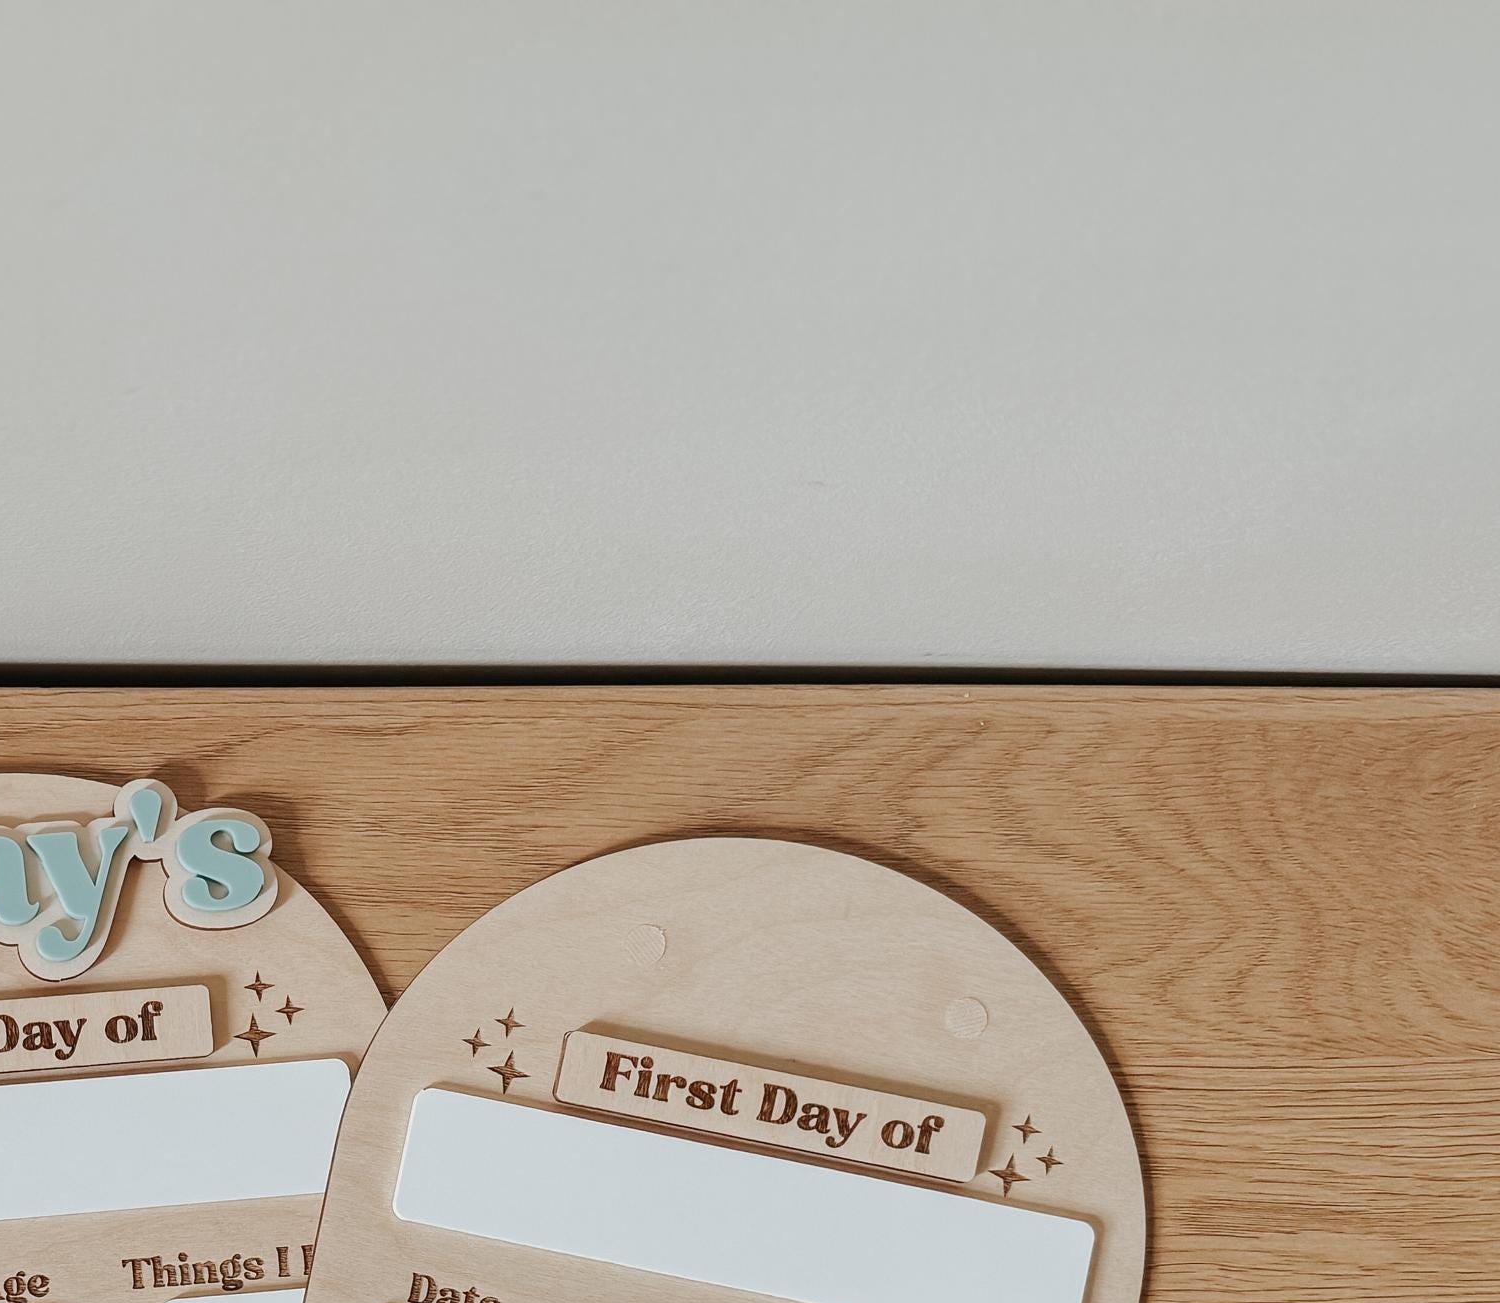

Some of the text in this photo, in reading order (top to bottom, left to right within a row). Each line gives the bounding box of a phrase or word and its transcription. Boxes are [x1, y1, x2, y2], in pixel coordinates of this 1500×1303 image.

[105, 1001, 164, 1044] of
[600, 1051, 945, 1155] First Day of
[122, 1251, 265, 1292] Things
[275, 1246, 291, 1277] I
